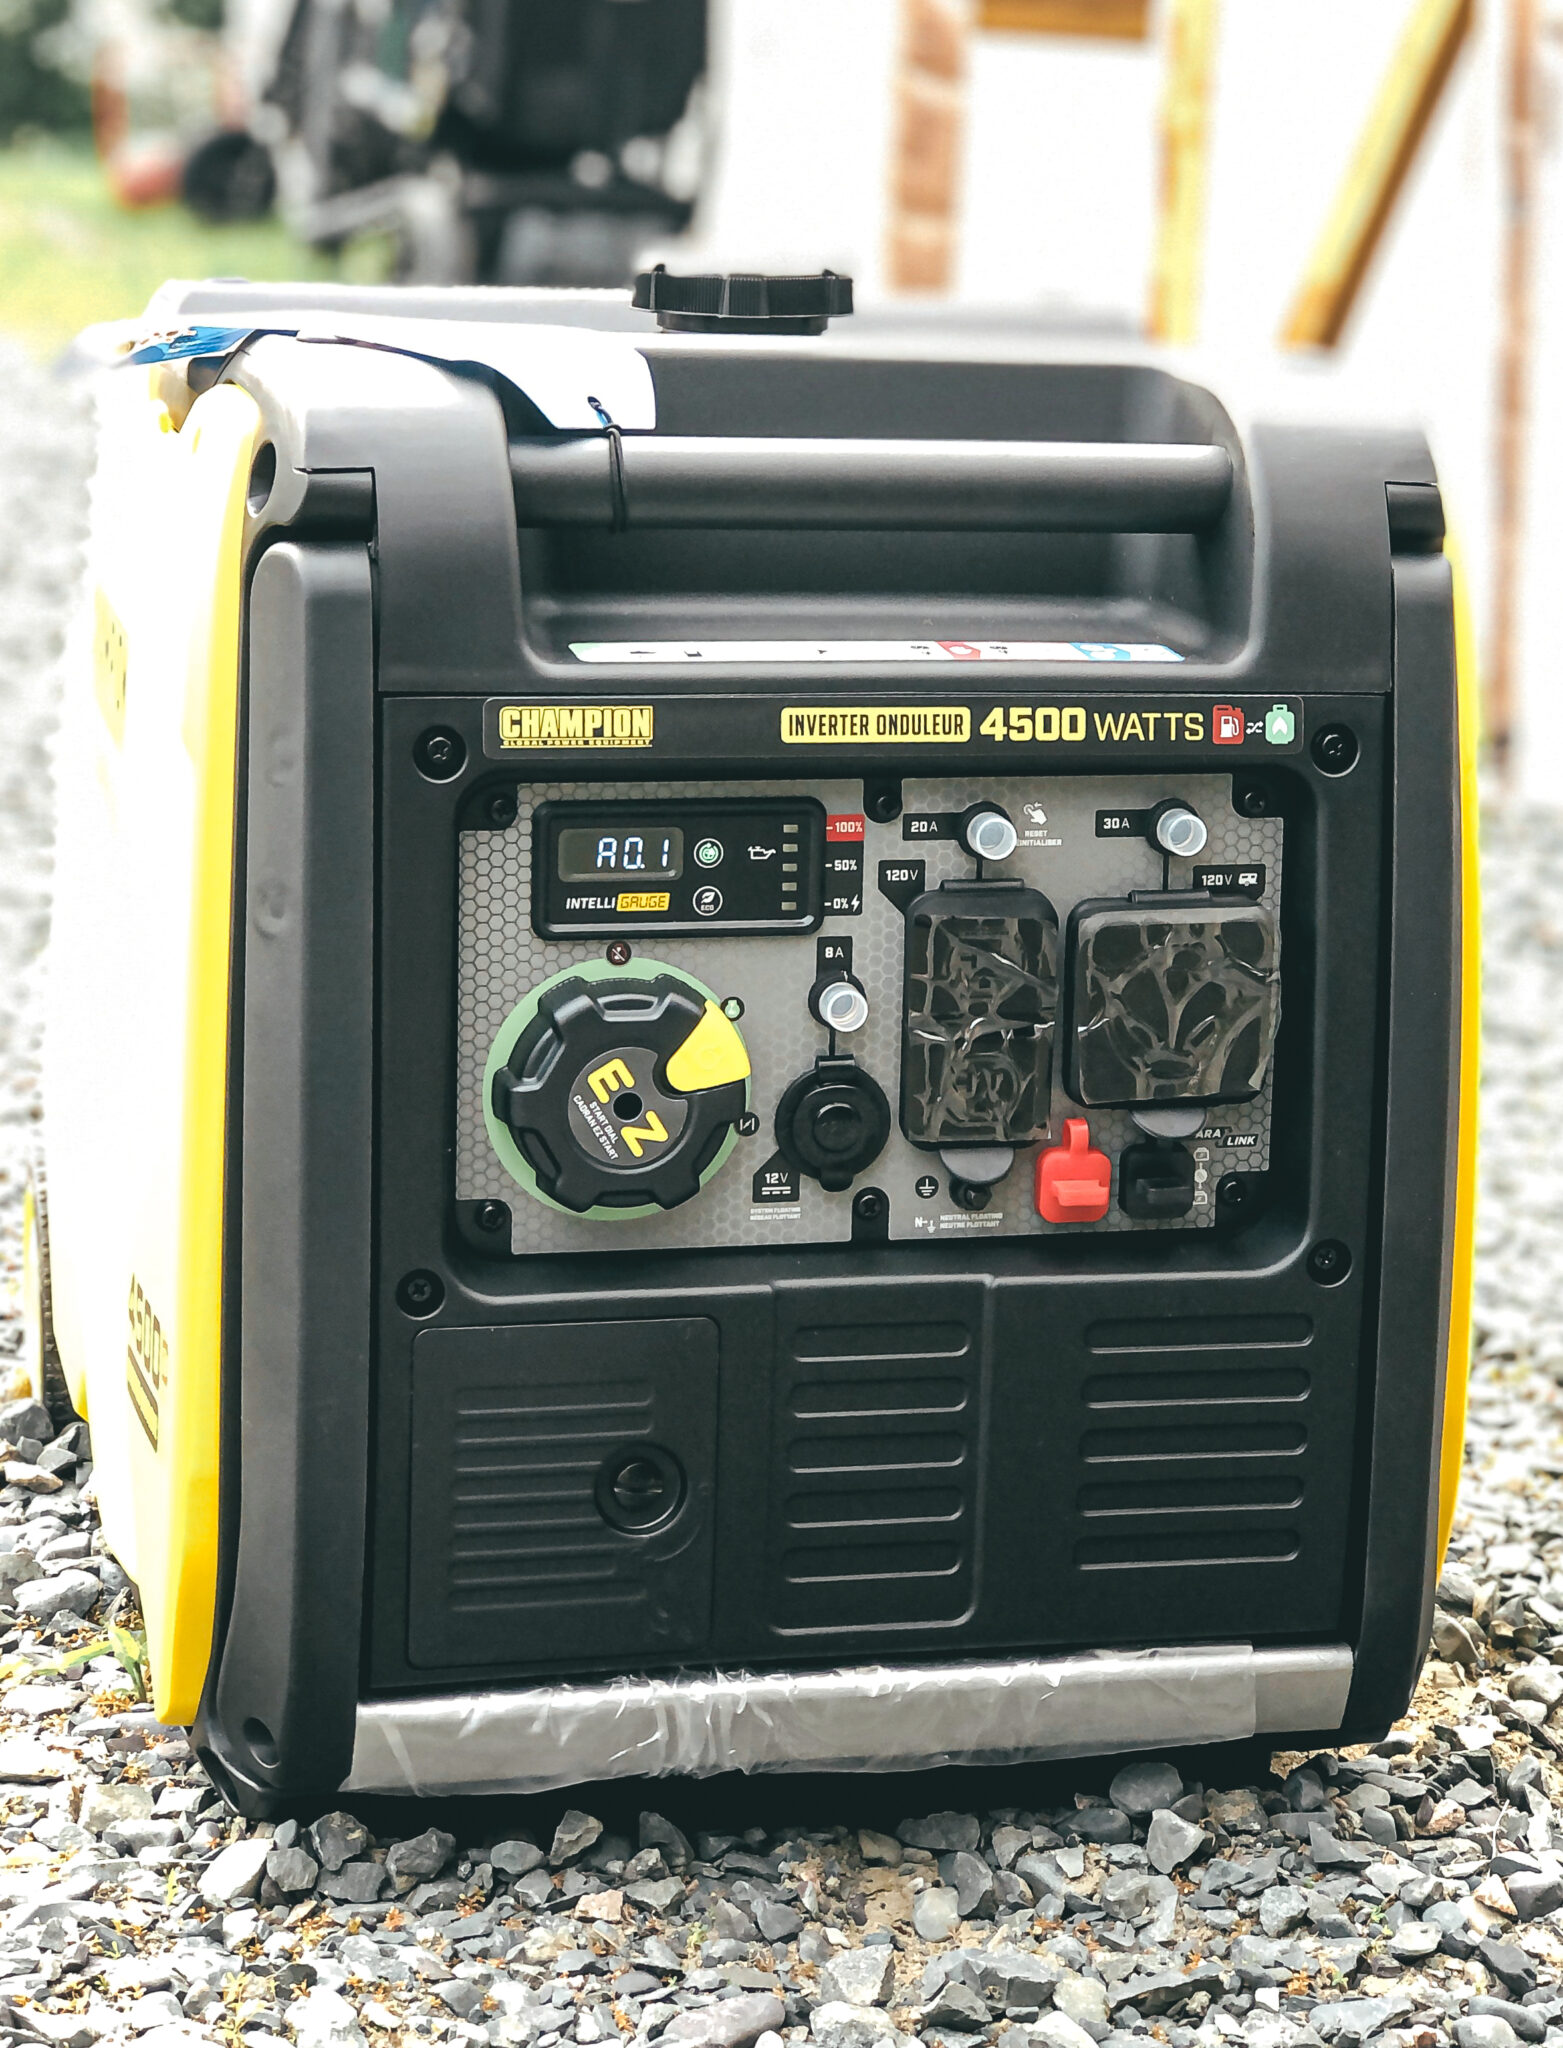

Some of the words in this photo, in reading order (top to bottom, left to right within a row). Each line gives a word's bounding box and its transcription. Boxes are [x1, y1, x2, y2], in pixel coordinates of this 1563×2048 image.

[501, 707, 651, 738] CHAMPION
[789, 714, 869, 736] INVERTER
[876, 713, 964, 736] ONDULEUR
[979, 706, 1087, 742] 4500
[1093, 712, 1204, 741] WATTS
[565, 896, 616, 910] INTELLI
[620, 894, 668, 909] GAUGE
[573, 1094, 598, 1127] CADRAN
[592, 1126, 604, 1138] EZ
[599, 1135, 619, 1160] START
[589, 1101, 609, 1126] START
[604, 1124, 619, 1144] DIAL
[1226, 1135, 1256, 1146] LINK
